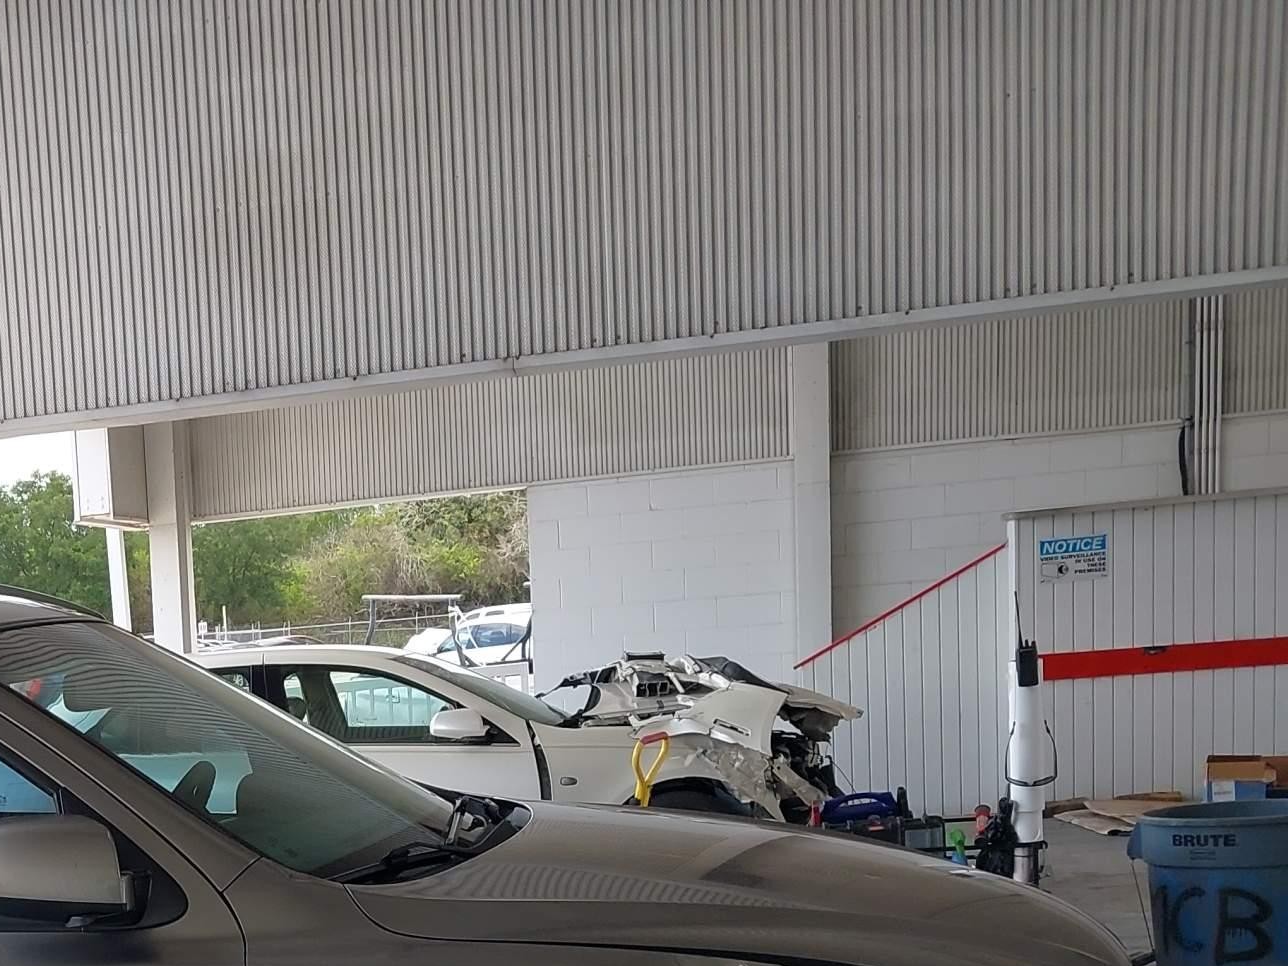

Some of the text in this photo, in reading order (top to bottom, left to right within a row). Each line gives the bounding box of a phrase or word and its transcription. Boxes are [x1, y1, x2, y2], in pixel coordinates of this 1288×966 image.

[1042, 537, 1104, 554] NOTICE
[1061, 551, 1106, 560] SURVEILLANCE
[1172, 833, 1237, 847] BRUTE
